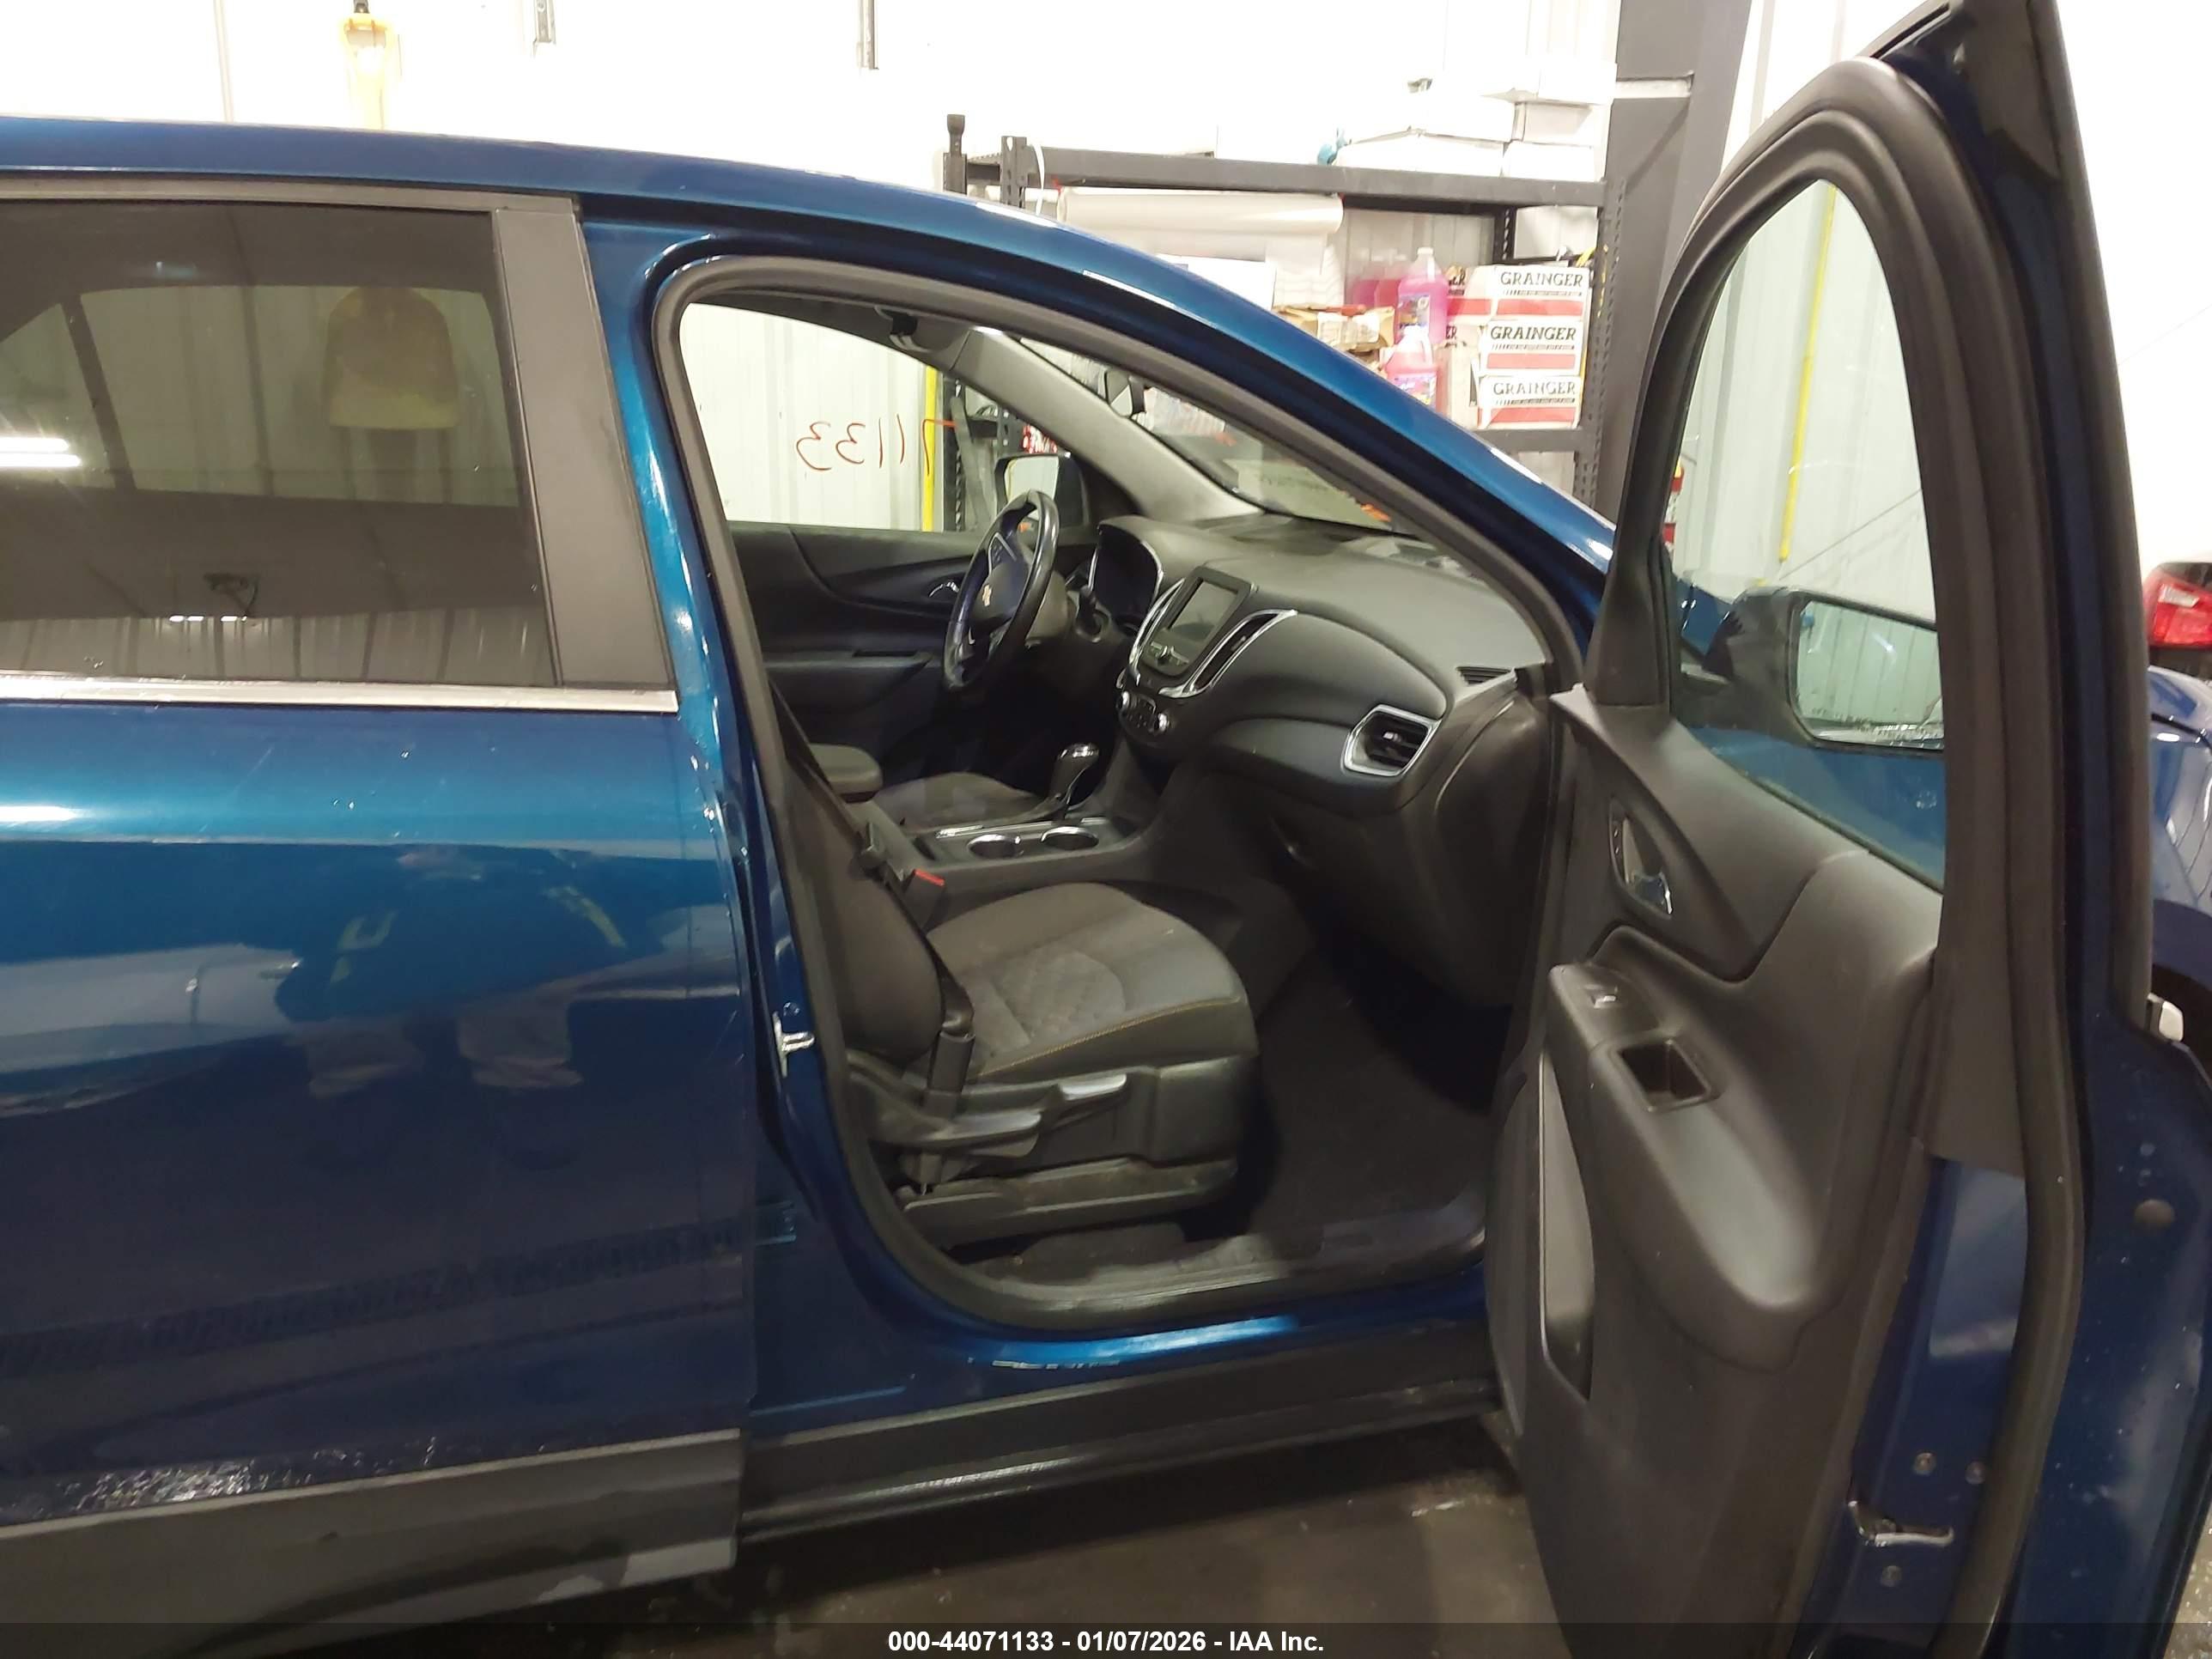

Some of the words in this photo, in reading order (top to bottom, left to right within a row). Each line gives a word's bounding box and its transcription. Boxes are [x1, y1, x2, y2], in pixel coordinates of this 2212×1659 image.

[1500, 271, 1583, 287] GRAINGER
[1490, 325, 1577, 341] GRAINGER
[1492, 381, 1576, 396] GRAINGER
